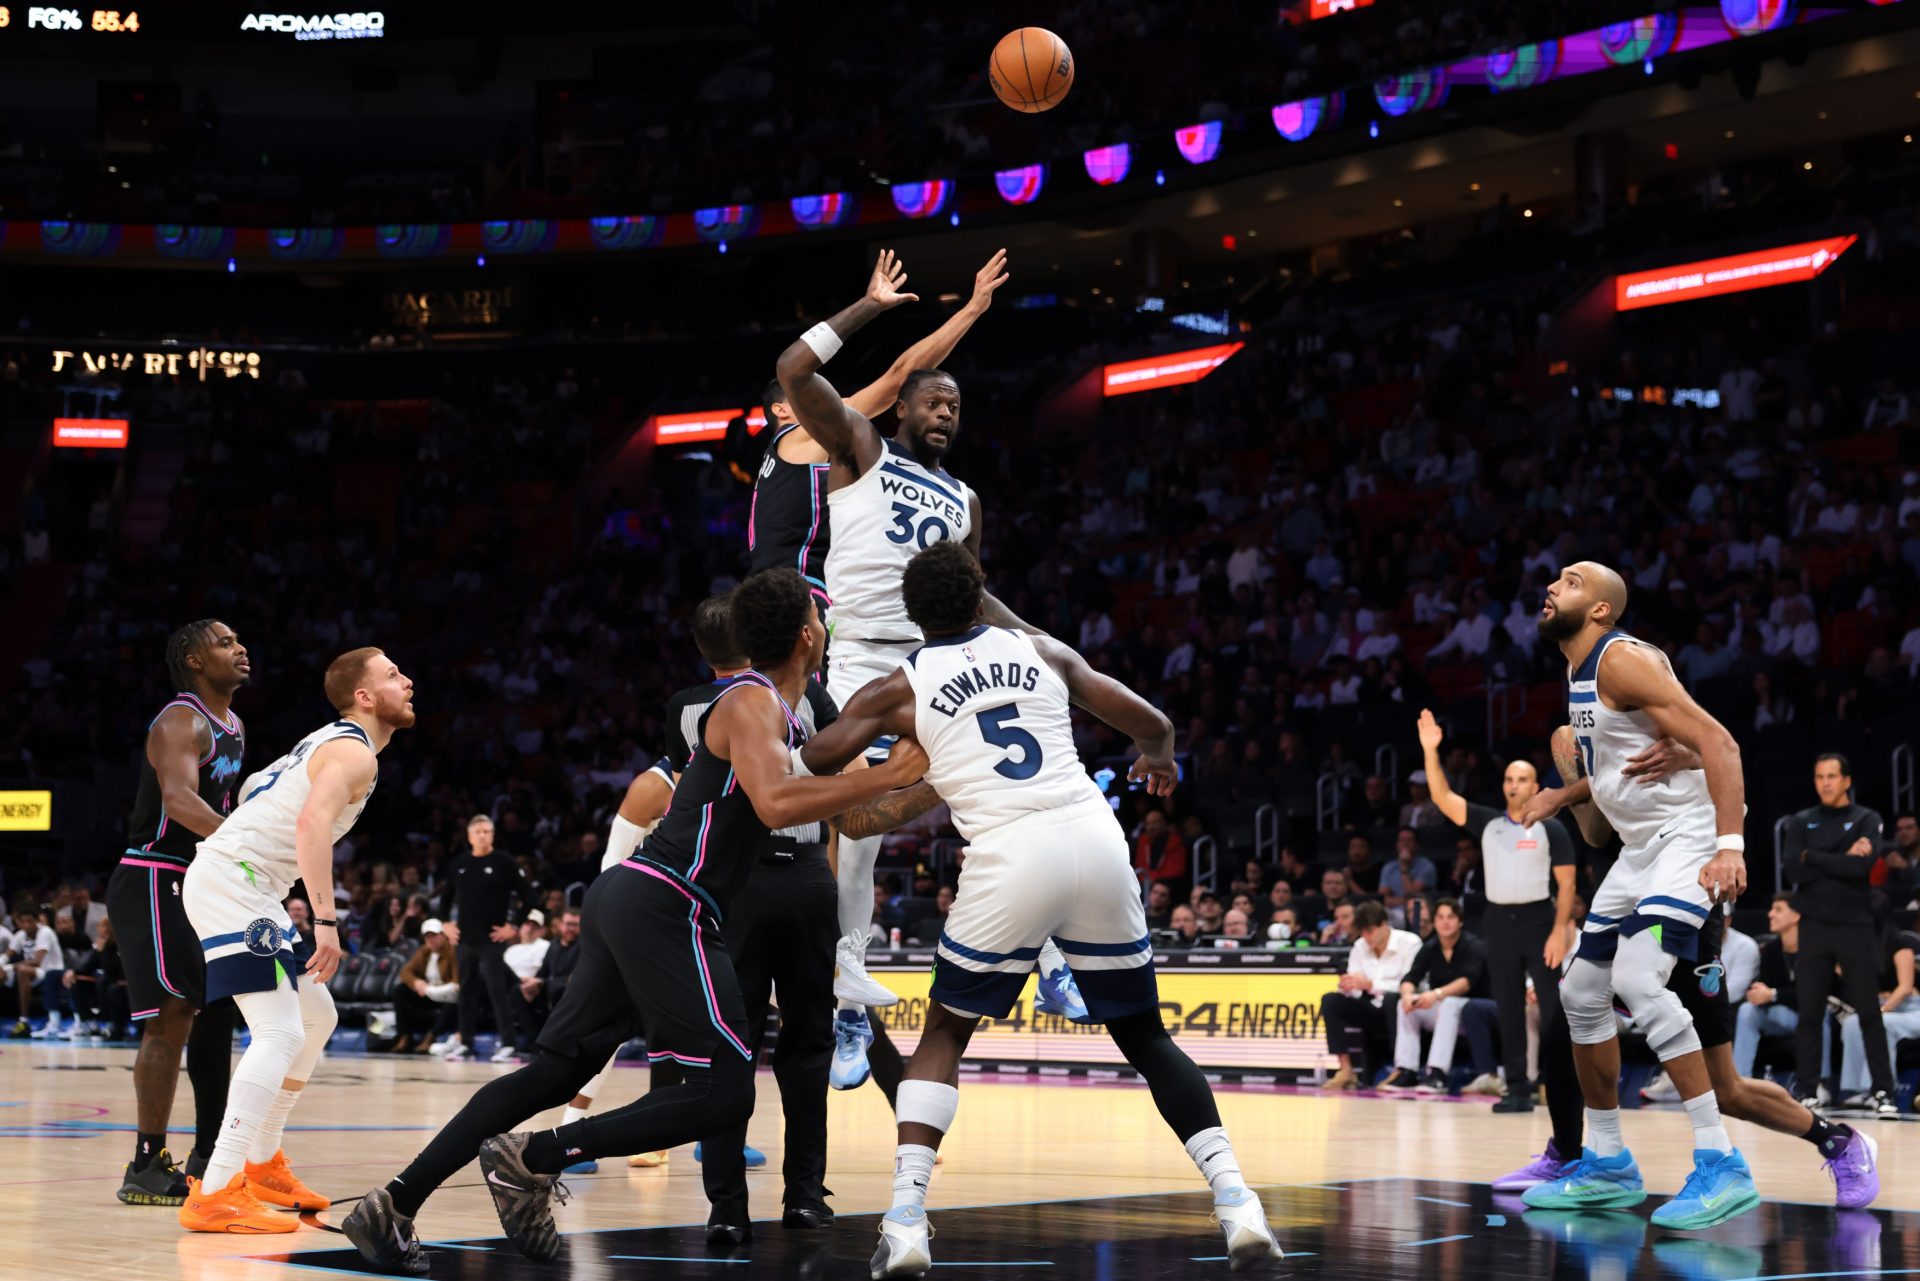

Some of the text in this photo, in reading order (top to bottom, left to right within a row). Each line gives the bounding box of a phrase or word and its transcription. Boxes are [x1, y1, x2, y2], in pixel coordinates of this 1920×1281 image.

[28, 7, 83, 30] FG%
[91, 10, 140, 32] 55.4
[240, 12, 385, 32] AROMA360
[880, 476, 963, 529] WOLVES
[885, 501, 949, 552] 30
[929, 662, 1040, 718] EDWARDS
[975, 701, 1043, 780] 5
[1228, 1003, 1325, 1039] ENERGY
